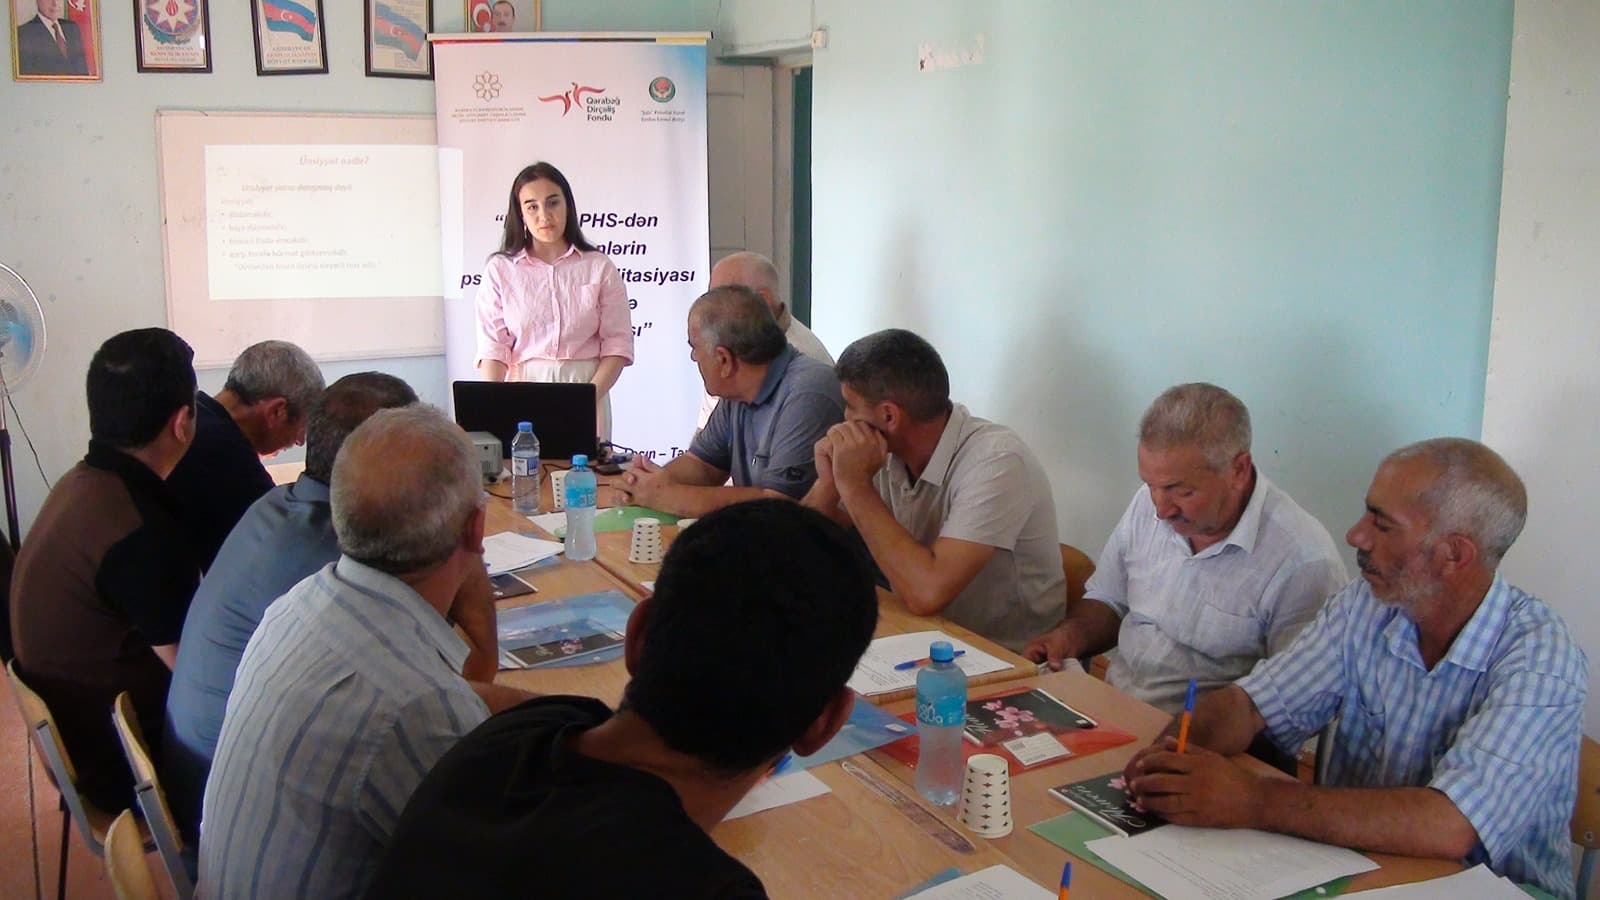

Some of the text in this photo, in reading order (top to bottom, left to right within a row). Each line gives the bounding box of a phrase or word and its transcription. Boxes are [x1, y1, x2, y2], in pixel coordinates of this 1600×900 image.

[586, 96, 621, 106] Qarabağ
[579, 212, 658, 228] PHS-dən
[597, 241, 647, 255] nlərin
[460, 273, 483, 289] ps
